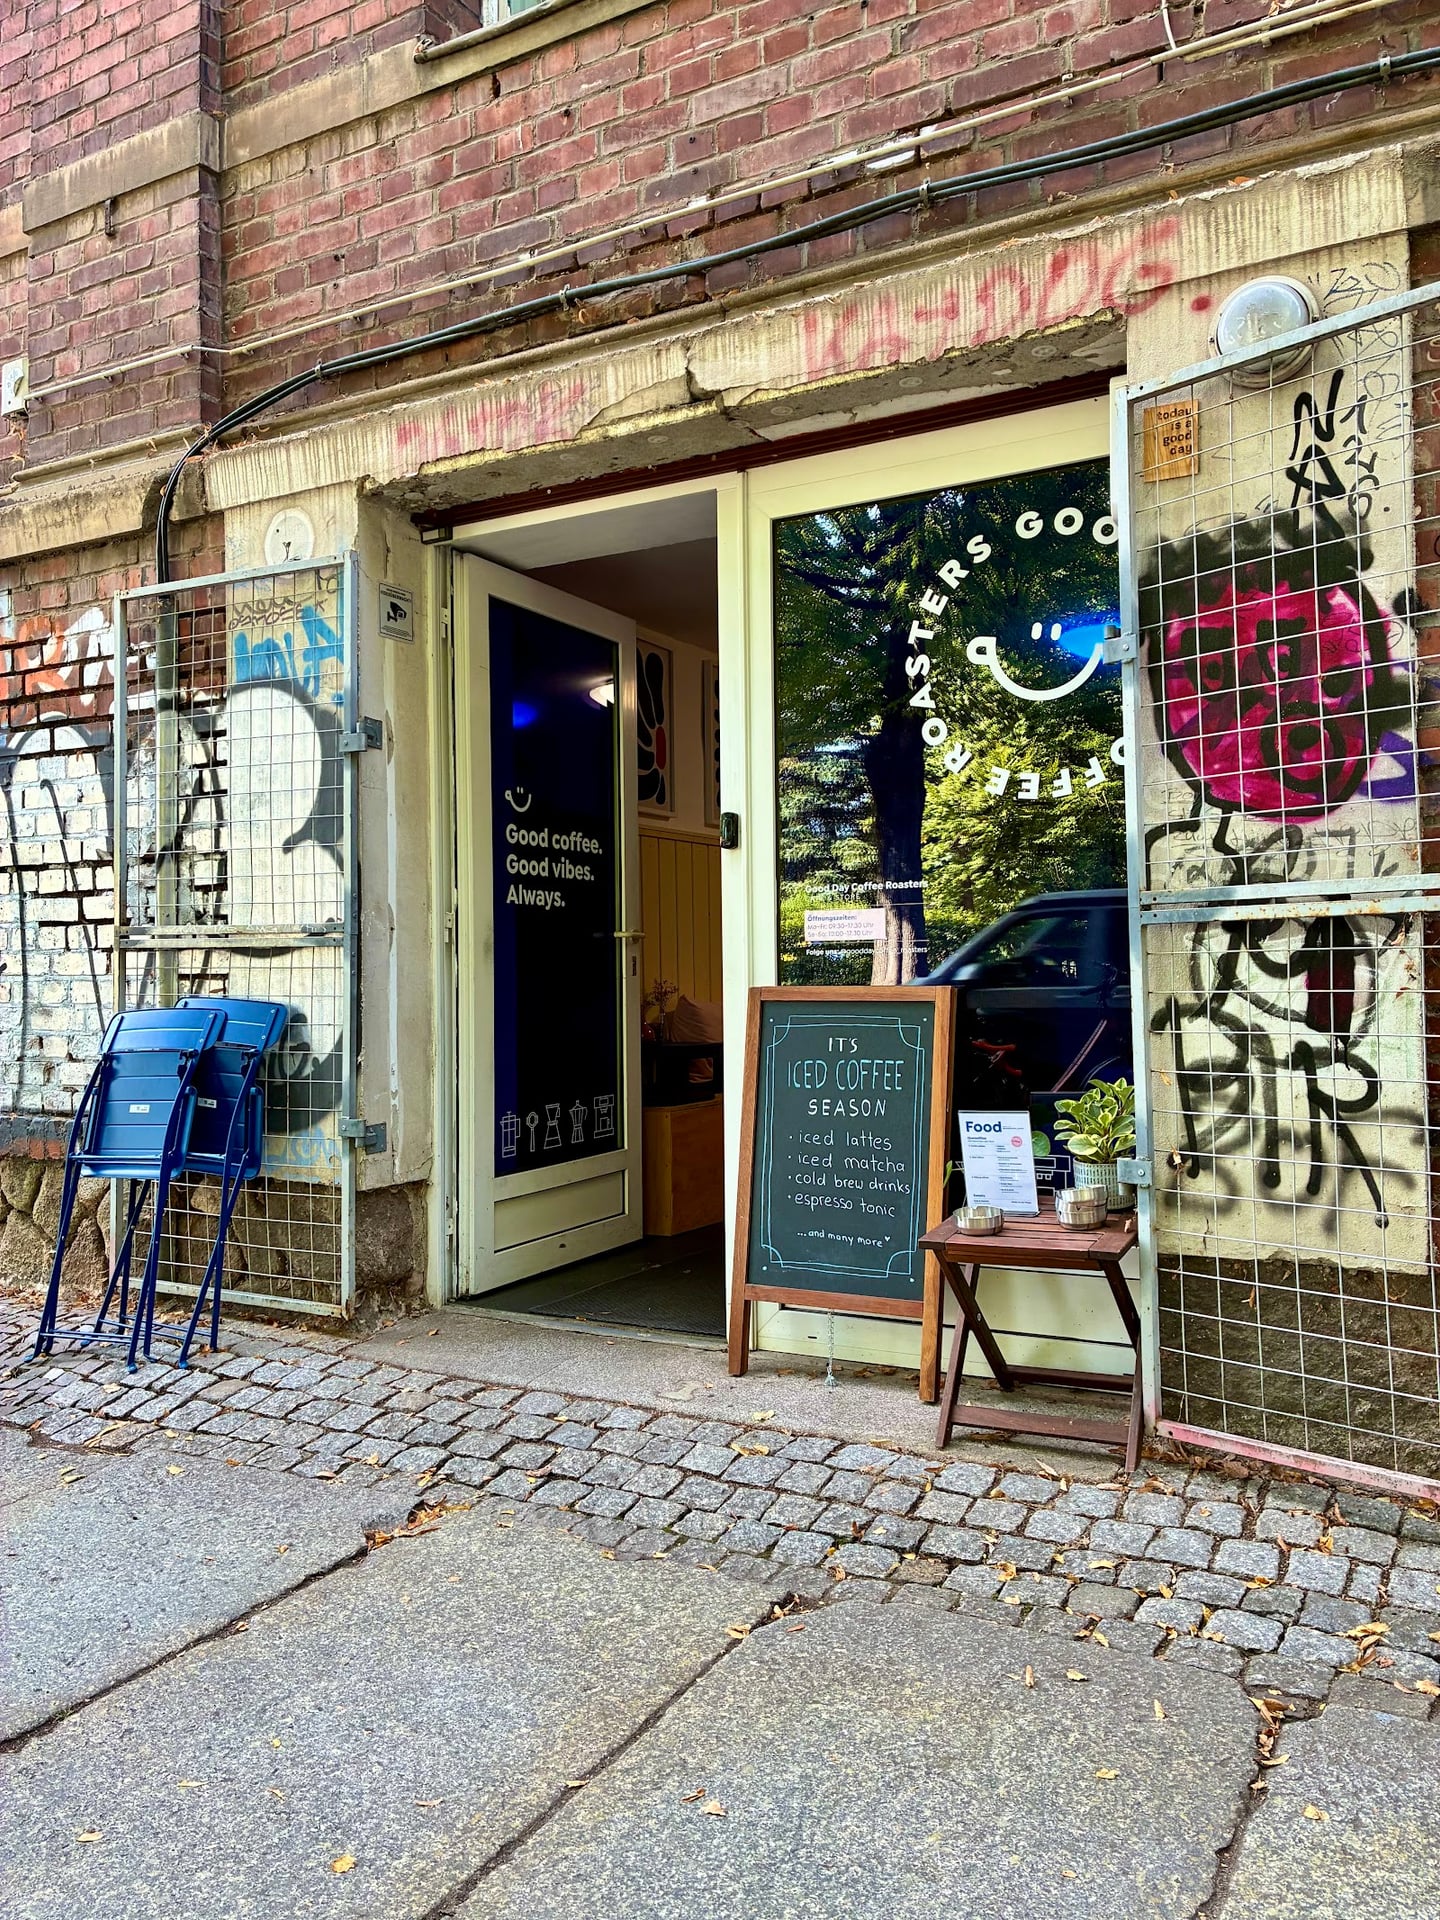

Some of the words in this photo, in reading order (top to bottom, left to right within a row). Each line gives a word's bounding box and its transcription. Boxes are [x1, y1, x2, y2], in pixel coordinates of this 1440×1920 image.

[1171, 421, 1181, 430] is
[1185, 420, 1192, 428] a
[1163, 430, 1192, 446] good
[1170, 444, 1192, 455] day
[1015, 507, 1119, 545] GOO
[905, 534, 992, 774] ROASTERS
[985, 736, 1125, 800] OFFEE
[505, 823, 549, 847] Good
[551, 831, 603, 855] coffee.
[506, 853, 549, 877] Good
[552, 856, 595, 881] vibes.
[805, 884, 830, 893] Good
[831, 882, 850, 894] Day
[851, 880, 884, 892] Coffee
[885, 879, 928, 890] Roasters
[506, 884, 566, 911] Always.
[805, 948, 825, 956] Folge
[828, 1037, 858, 1053] IT'S
[787, 1060, 828, 1088] ICED
[836, 1059, 904, 1090] COFFEE
[807, 1098, 886, 1117] SEASON
[965, 1121, 1002, 1133] Food
[799, 1129, 834, 1145] iced
[846, 1129, 892, 1151] lattes
[798, 1151, 832, 1168] iced
[844, 1154, 905, 1172] matcha
[795, 1171, 826, 1186] cold
[834, 1174, 864, 1190] brew
[869, 1177, 911, 1194] drinks
[794, 1193, 853, 1212] espresso
[859, 1198, 896, 1217] tonic
[828, 1232, 854, 1246] many
[857, 1236, 883, 1248] more
